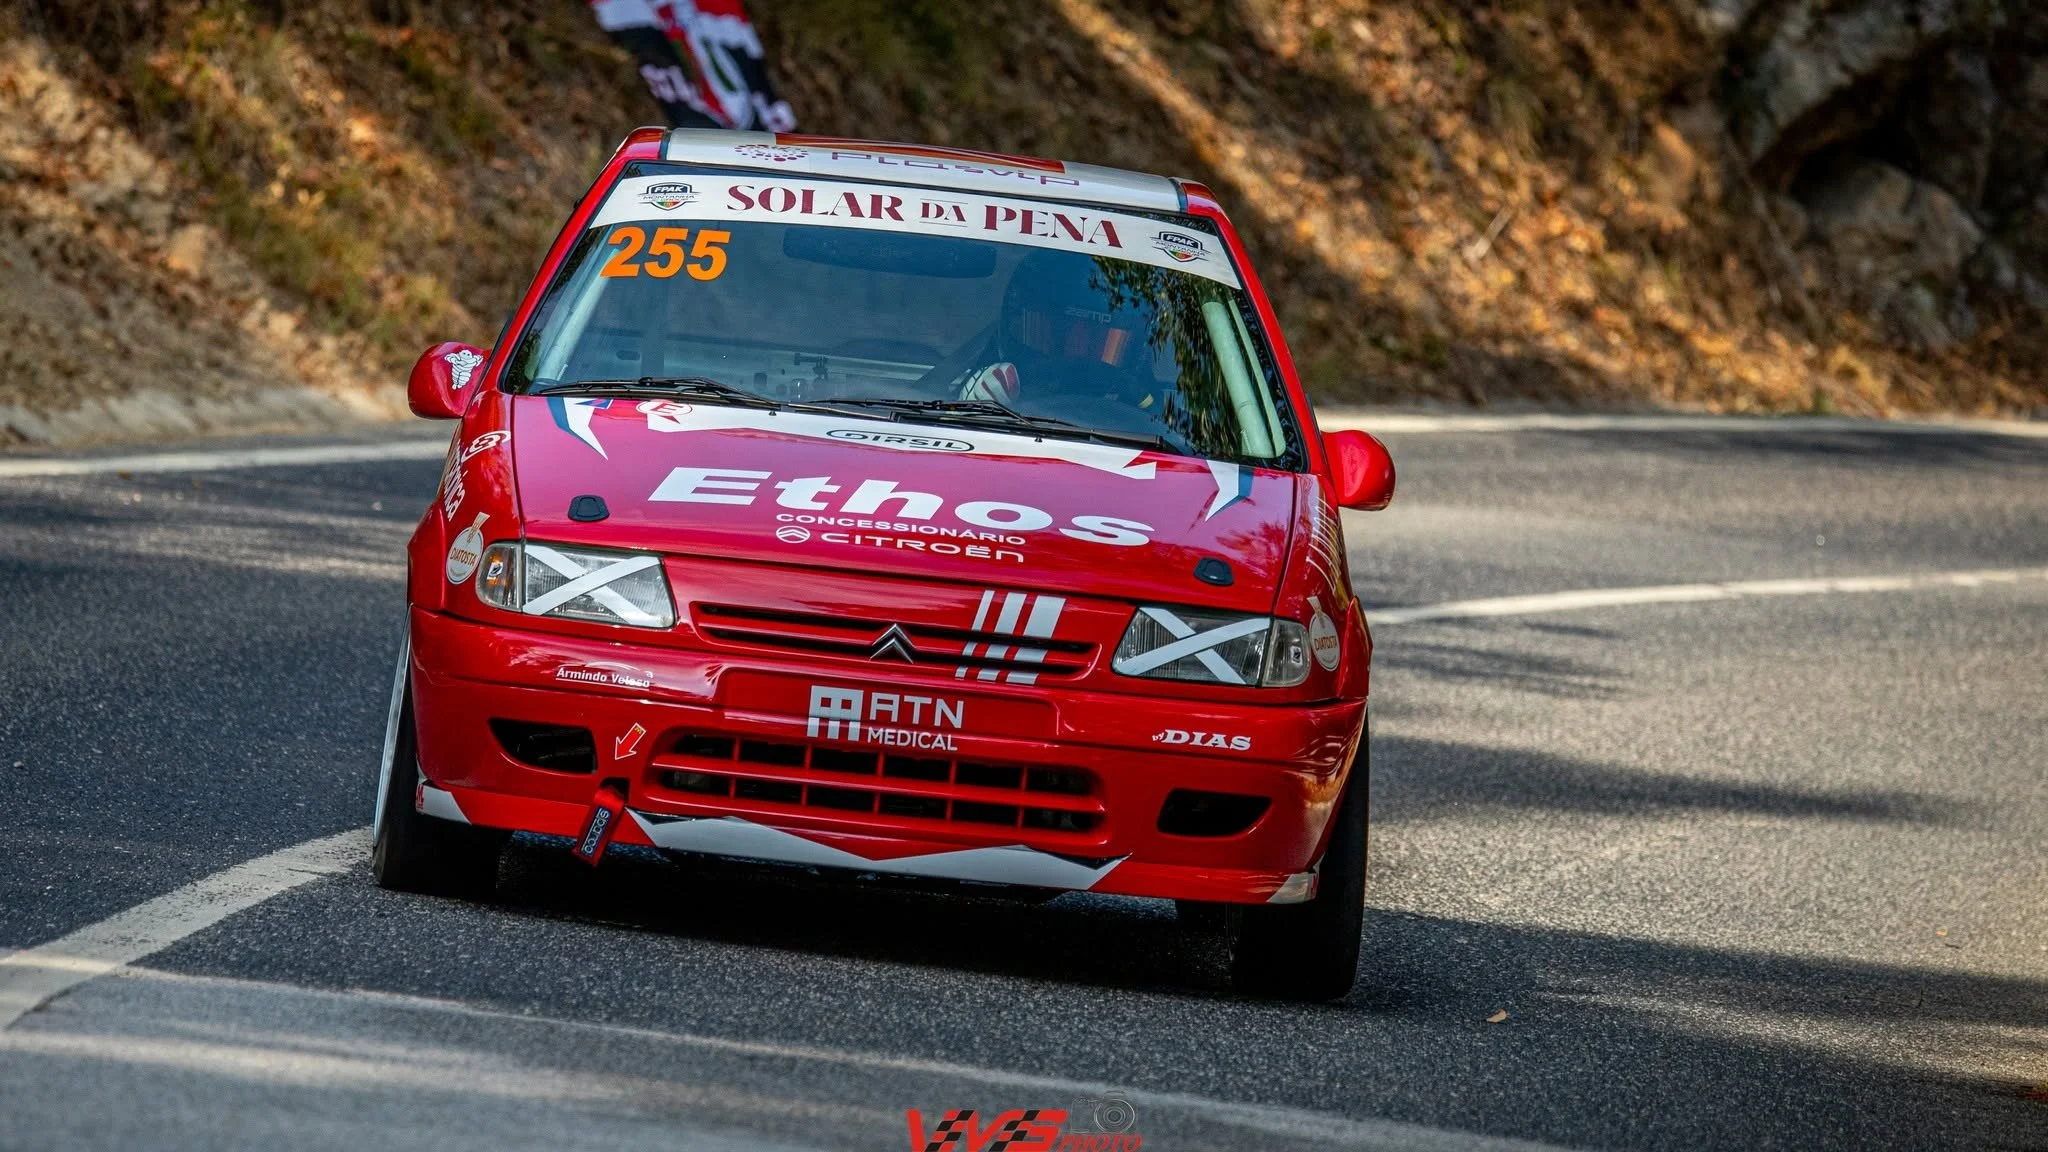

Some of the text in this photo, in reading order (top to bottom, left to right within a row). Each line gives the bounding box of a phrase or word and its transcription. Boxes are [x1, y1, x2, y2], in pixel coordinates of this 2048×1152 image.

[727, 184, 1123, 248] SOLAR DA PENA
[600, 226, 731, 281] 255
[1166, 235, 1195, 247] FPAK
[844, 432, 963, 450] DIRSIL
[648, 467, 1156, 546] Ethos
[776, 513, 1026, 545] CONCESSIONÁRIO
[556, 667, 608, 682] Armindo
[869, 692, 965, 728] ATN
[867, 727, 958, 751] MEDICAL
[1161, 729, 1251, 751] DIAS
